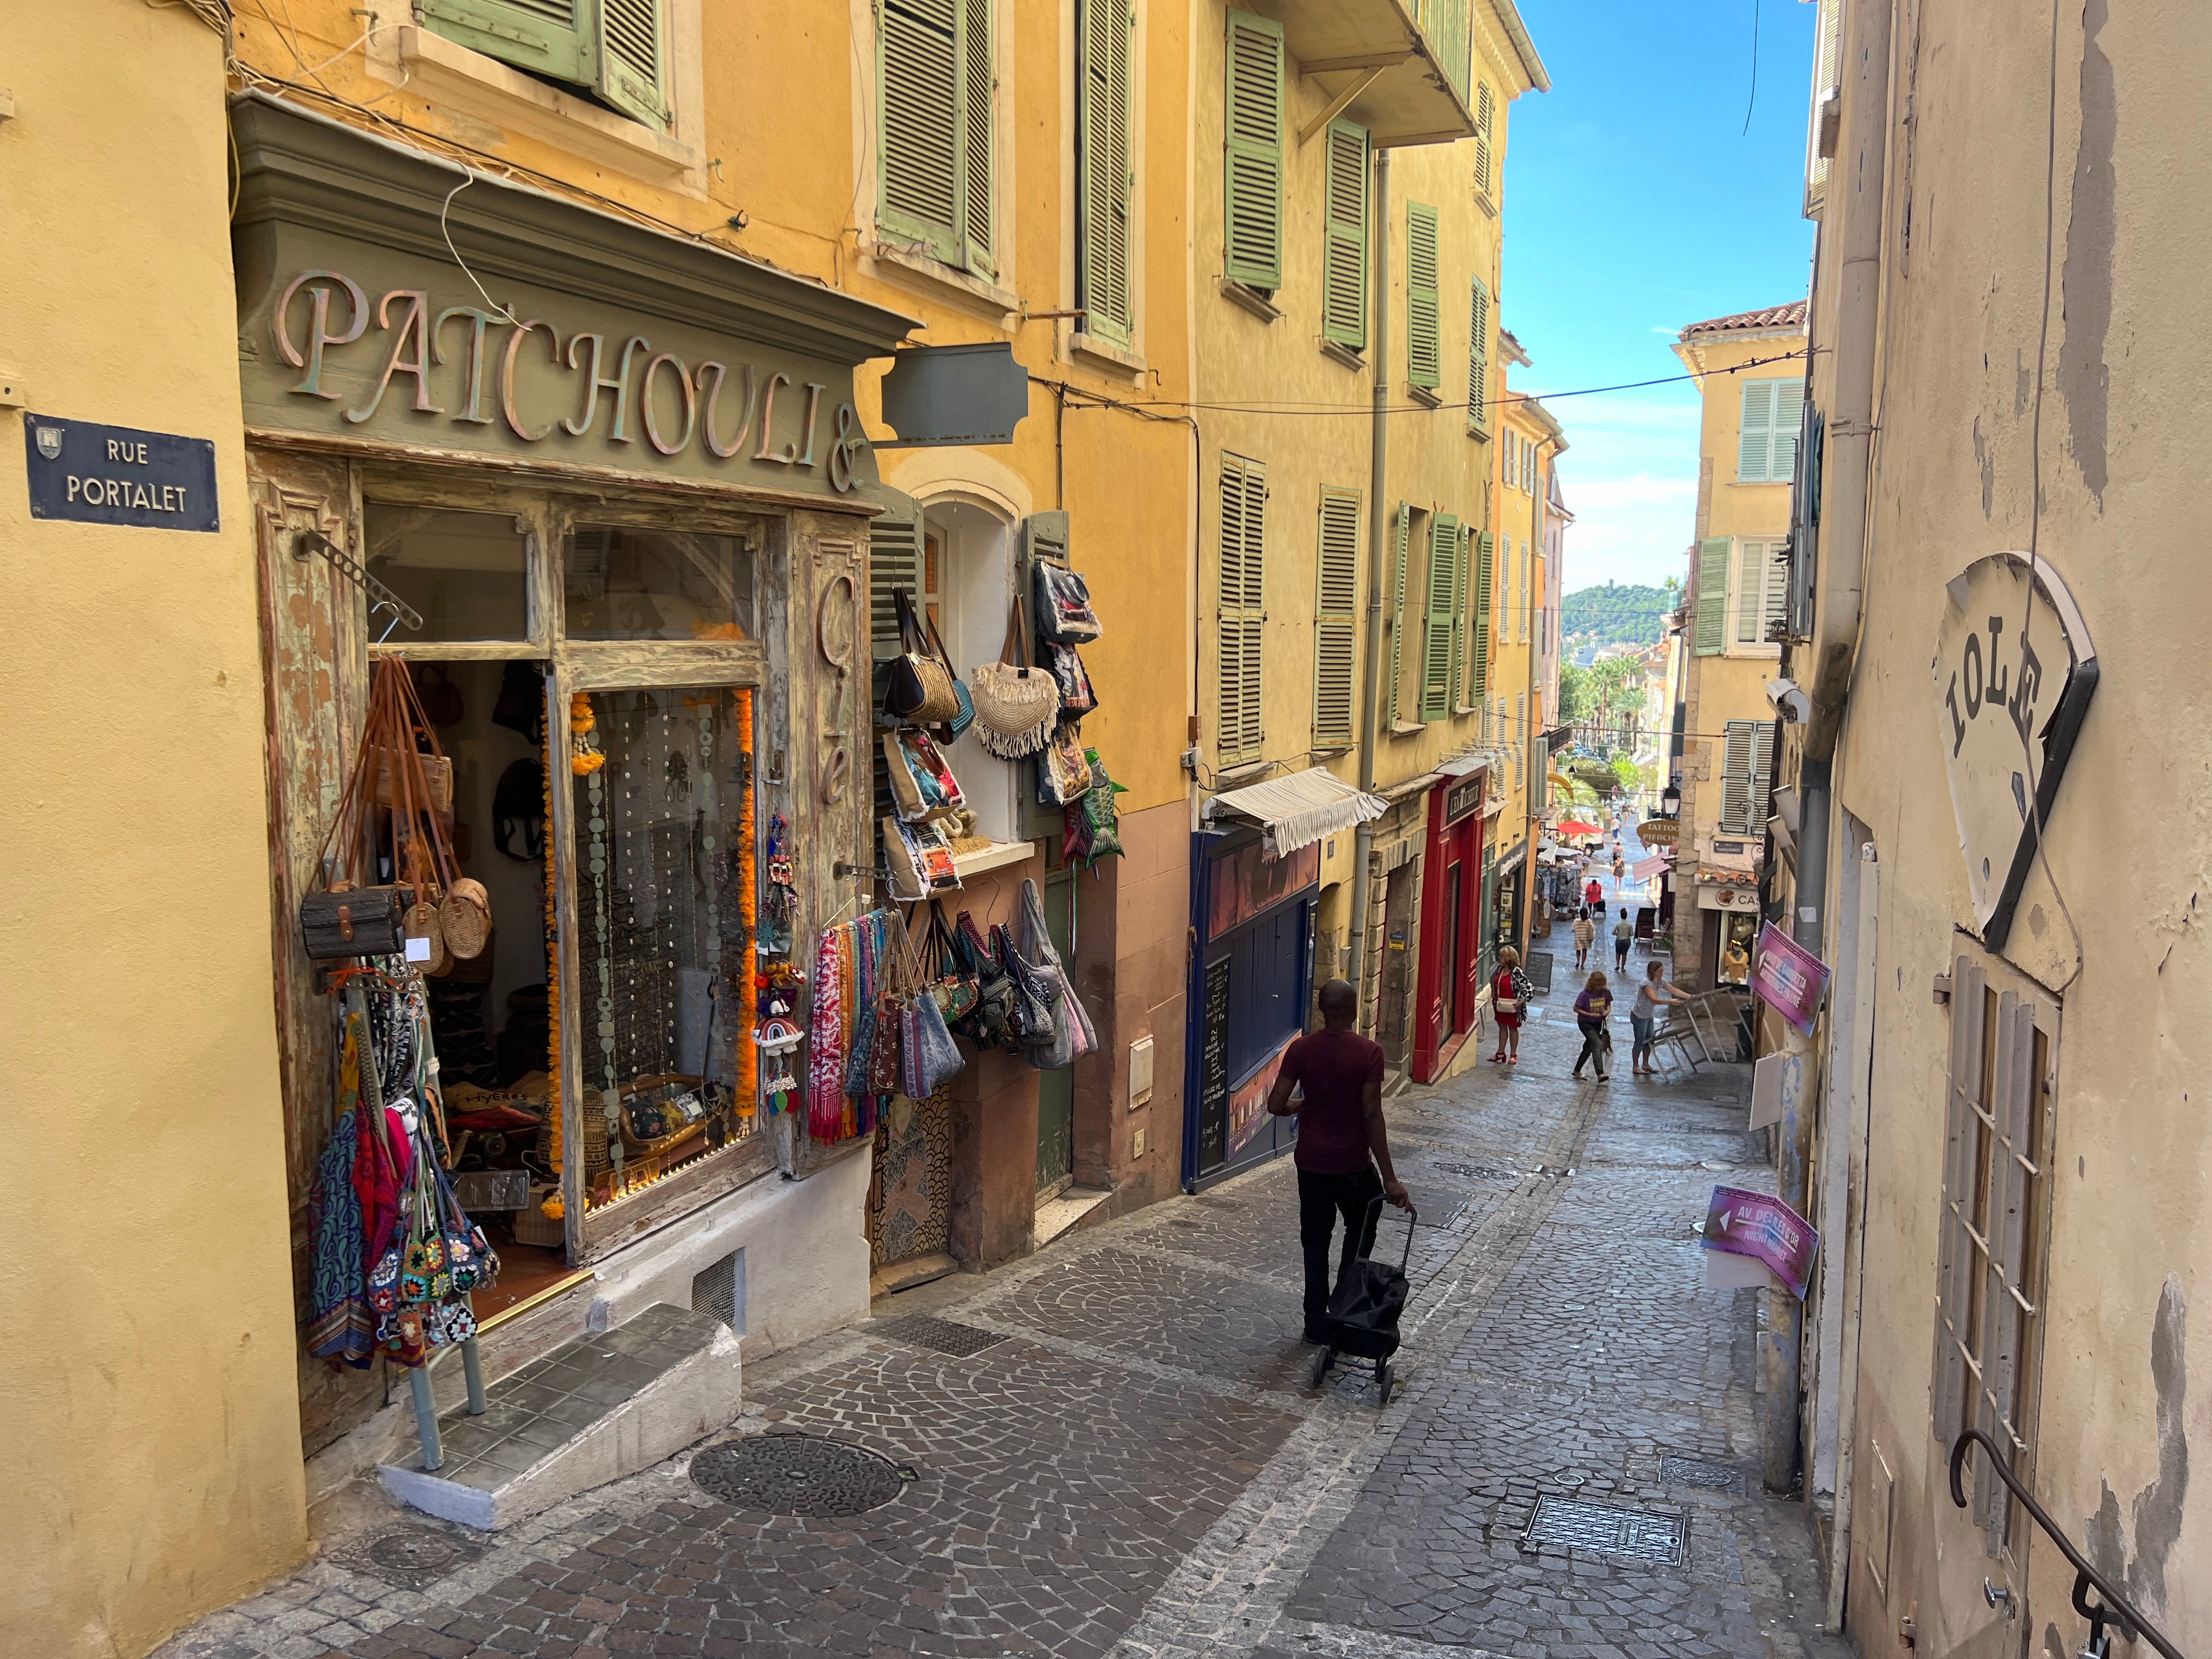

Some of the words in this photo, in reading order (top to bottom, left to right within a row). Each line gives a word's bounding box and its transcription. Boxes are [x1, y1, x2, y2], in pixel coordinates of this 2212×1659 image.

[272, 269, 827, 469] PATCHOULI
[827, 402, 866, 494] &
[106, 439, 149, 465] RUE
[66, 475, 187, 513] PORTALET
[1765, 1237, 1787, 1262] MARKET
[1784, 1227, 1799, 1249] D'OR
